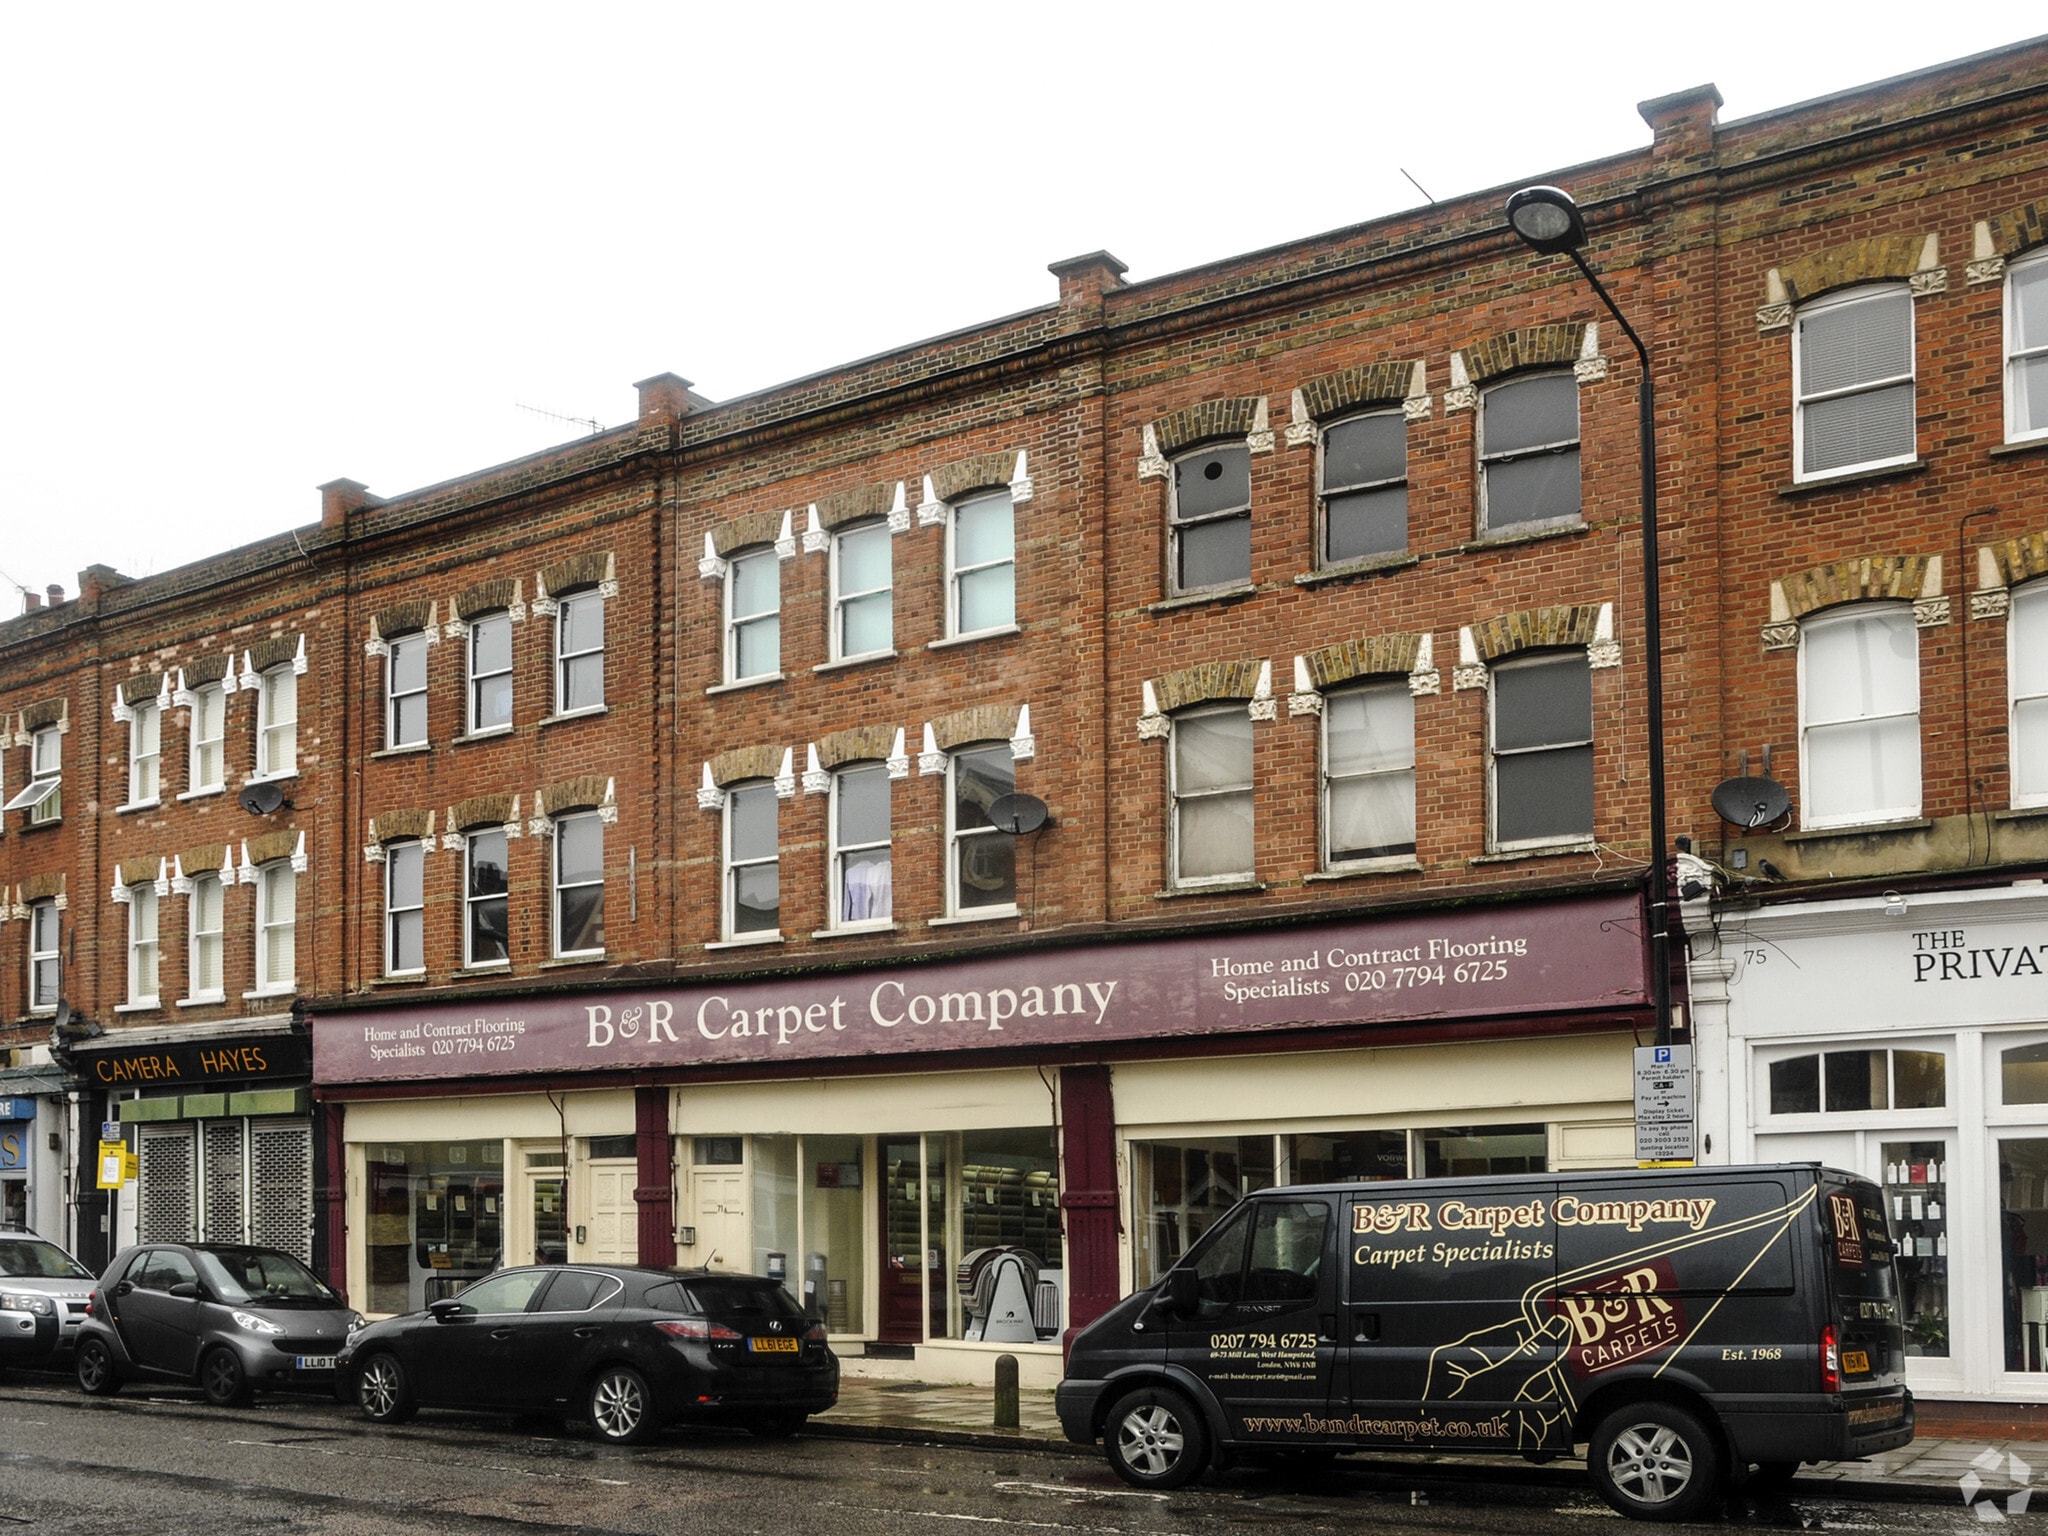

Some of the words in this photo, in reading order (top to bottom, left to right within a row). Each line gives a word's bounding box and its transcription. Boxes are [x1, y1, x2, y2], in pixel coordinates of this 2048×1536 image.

[1912, 930, 1966, 950] THE
[1211, 957, 1274, 977] Home
[1280, 951, 1320, 972] and
[1327, 945, 1421, 968] Contract
[1428, 935, 1528, 960] Flooring
[1745, 949, 1767, 965] 75
[1223, 977, 1330, 1004] Specialists
[1344, 970, 1386, 992] 020
[1392, 965, 1446, 989] 7794
[1453, 959, 1508, 983] 6725
[584, 999, 680, 1048] B&R
[696, 994, 848, 1046] Carpet
[868, 979, 1118, 1031] Company
[364, 1026, 397, 1042] Home
[400, 1024, 420, 1039] and
[423, 1022, 472, 1038] Contract
[474, 1017, 526, 1034] Flooring
[370, 1043, 426, 1061] Specialists
[432, 1039, 454, 1055] 020
[456, 1038, 484, 1054] 7794
[486, 1035, 516, 1051] 6725
[1658, 1049, 1669, 1061] P
[96, 1055, 181, 1082] CAMERA
[199, 1047, 268, 1074] HAYES
[1353, 1202, 1433, 1235] B&R
[1438, 1199, 1545, 1238] Carpet
[1550, 1195, 1716, 1232] Company
[1830, 1195, 1860, 1241] B&R
[1354, 1243, 1426, 1270] Carpet
[1432, 1239, 1554, 1268] Specialists
[1236, 1305, 1282, 1313] TRANSIT
[1559, 1267, 1674, 1346] B&R
[755, 1339, 777, 1351] LL61
[778, 1338, 796, 1351] EGE
[1210, 1334, 1245, 1349] 0207
[1249, 1333, 1277, 1349] 794
[1280, 1333, 1317, 1349] 6725
[1581, 1315, 1677, 1367] CARPETS
[1721, 1348, 1747, 1361] Est.
[1751, 1347, 1782, 1361] 1968
[304, 1358, 326, 1368] LL10
[1257, 1361, 1283, 1369] London,
[1243, 1412, 1511, 1442] www.bandrcarpet.co.uk
